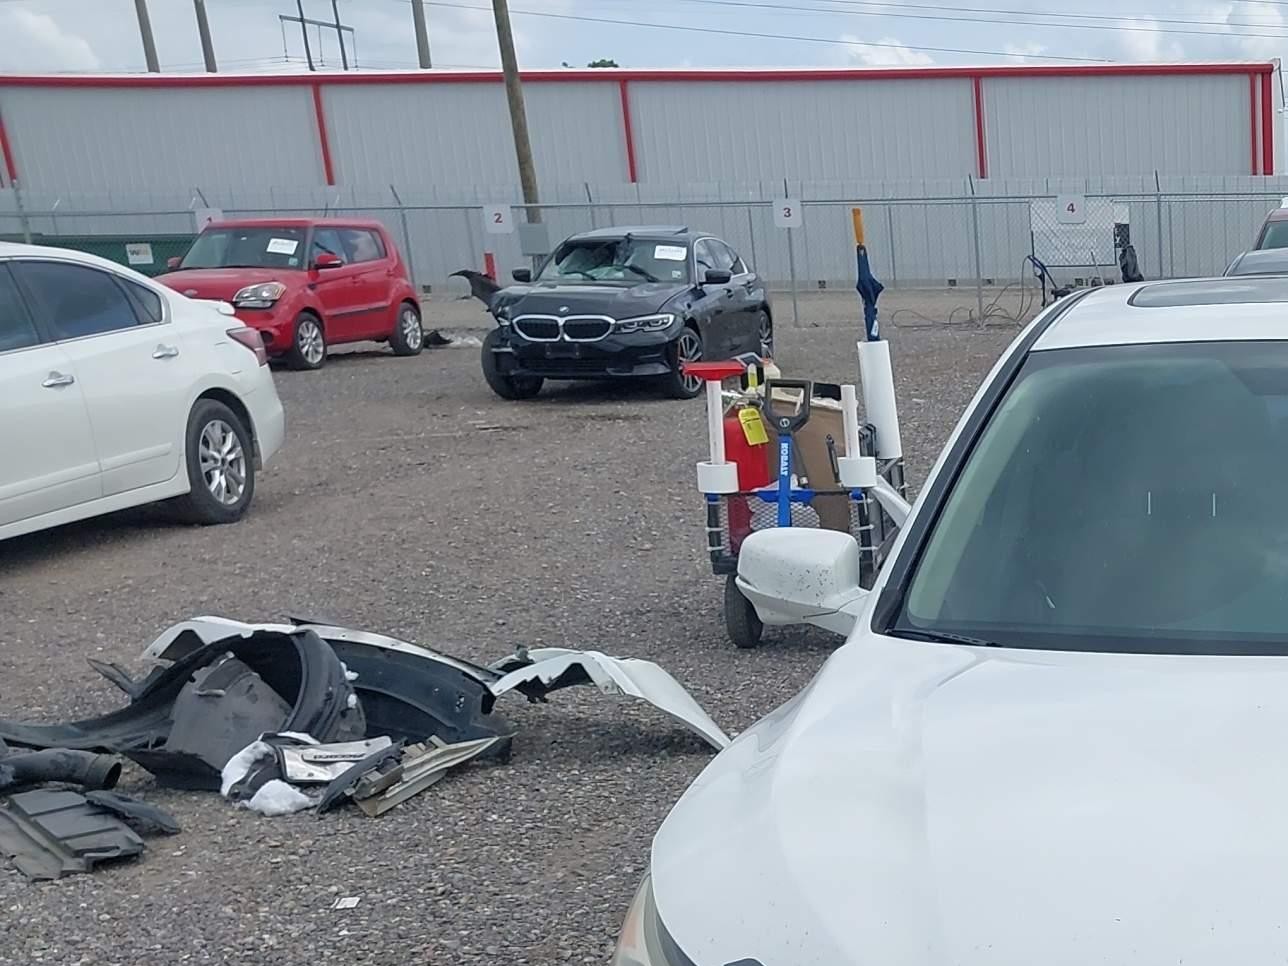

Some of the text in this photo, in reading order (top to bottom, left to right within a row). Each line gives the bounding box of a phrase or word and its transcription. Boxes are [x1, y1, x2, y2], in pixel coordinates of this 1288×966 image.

[783, 207, 792, 218] 3
[1066, 203, 1076, 213] 4
[494, 212, 503, 224] 2
[780, 443, 789, 476] KOBALT
